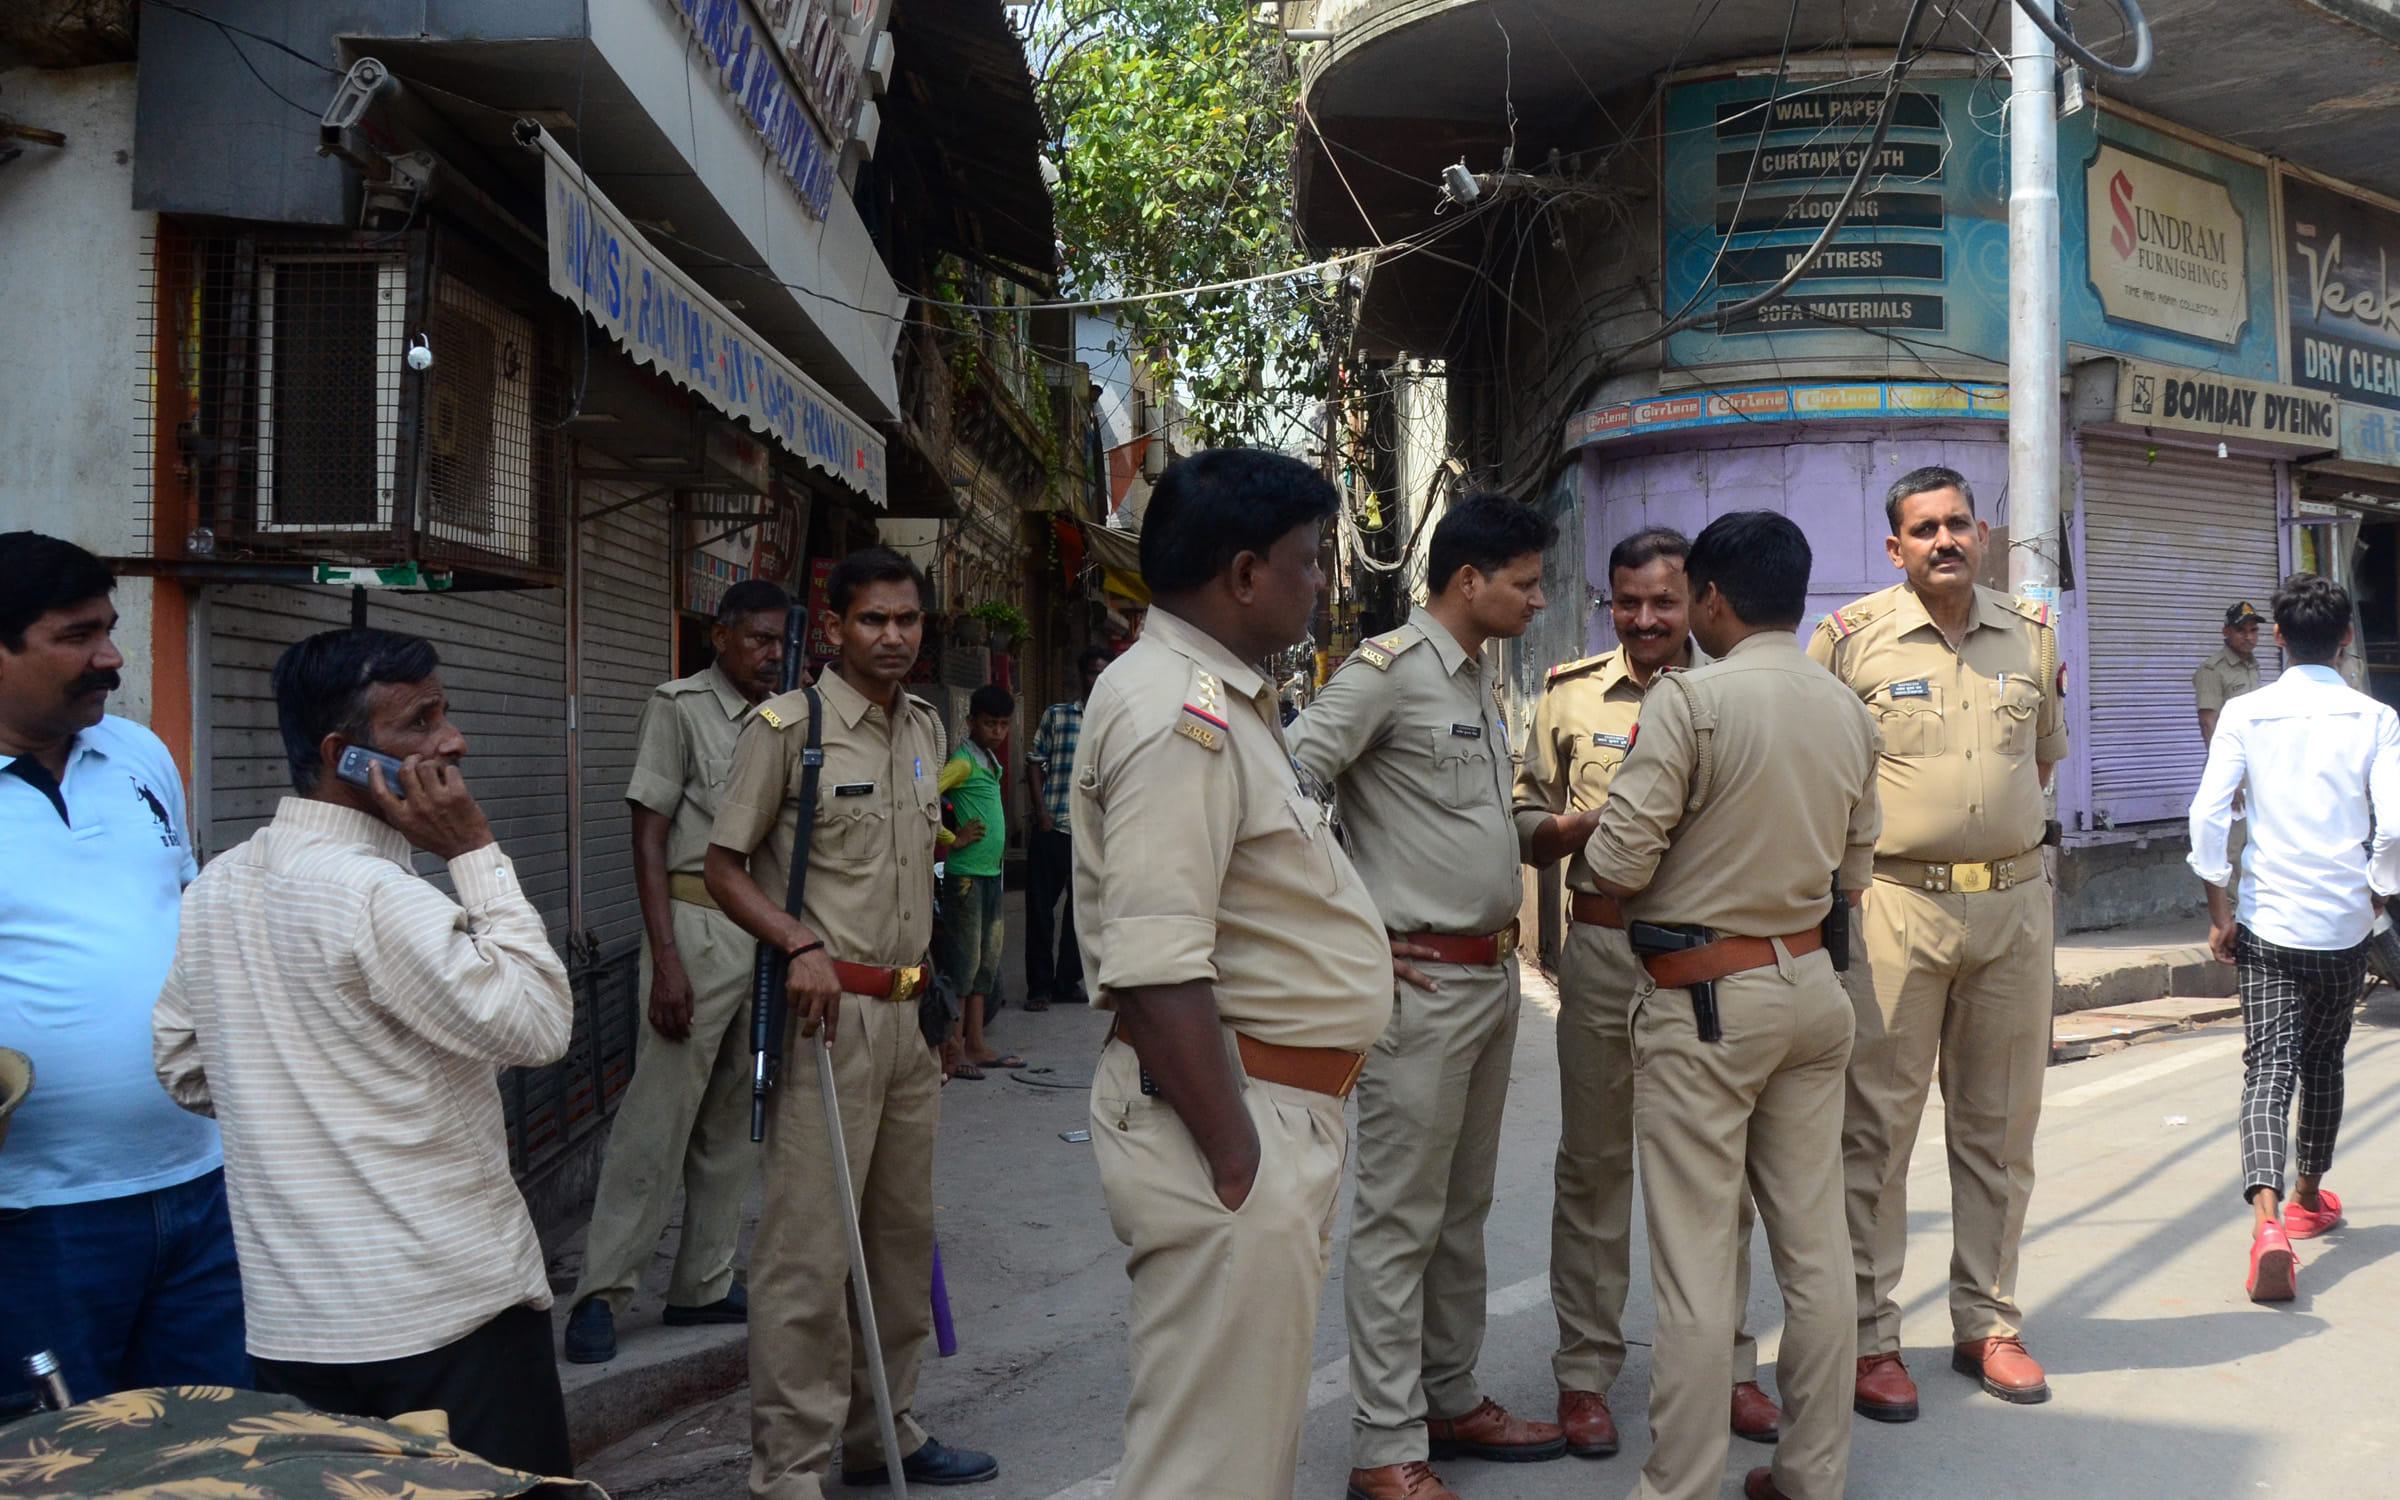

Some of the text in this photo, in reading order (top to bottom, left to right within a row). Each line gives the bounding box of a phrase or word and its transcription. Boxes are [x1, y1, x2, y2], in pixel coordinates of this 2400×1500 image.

[1776, 101, 1824, 121] WALL
[1762, 151, 1839, 172] CURTAIN
[2110, 168, 2226, 264] SUNDRAM
[1786, 251, 1882, 270] MTTRESS
[2138, 248, 2229, 290] FURNISHINGS
[1758, 302, 1912, 322] SOFA MATERIALS
[2304, 337, 2400, 396] DRY CLEA
[2163, 379, 2332, 438] BOMBAY DYEING
